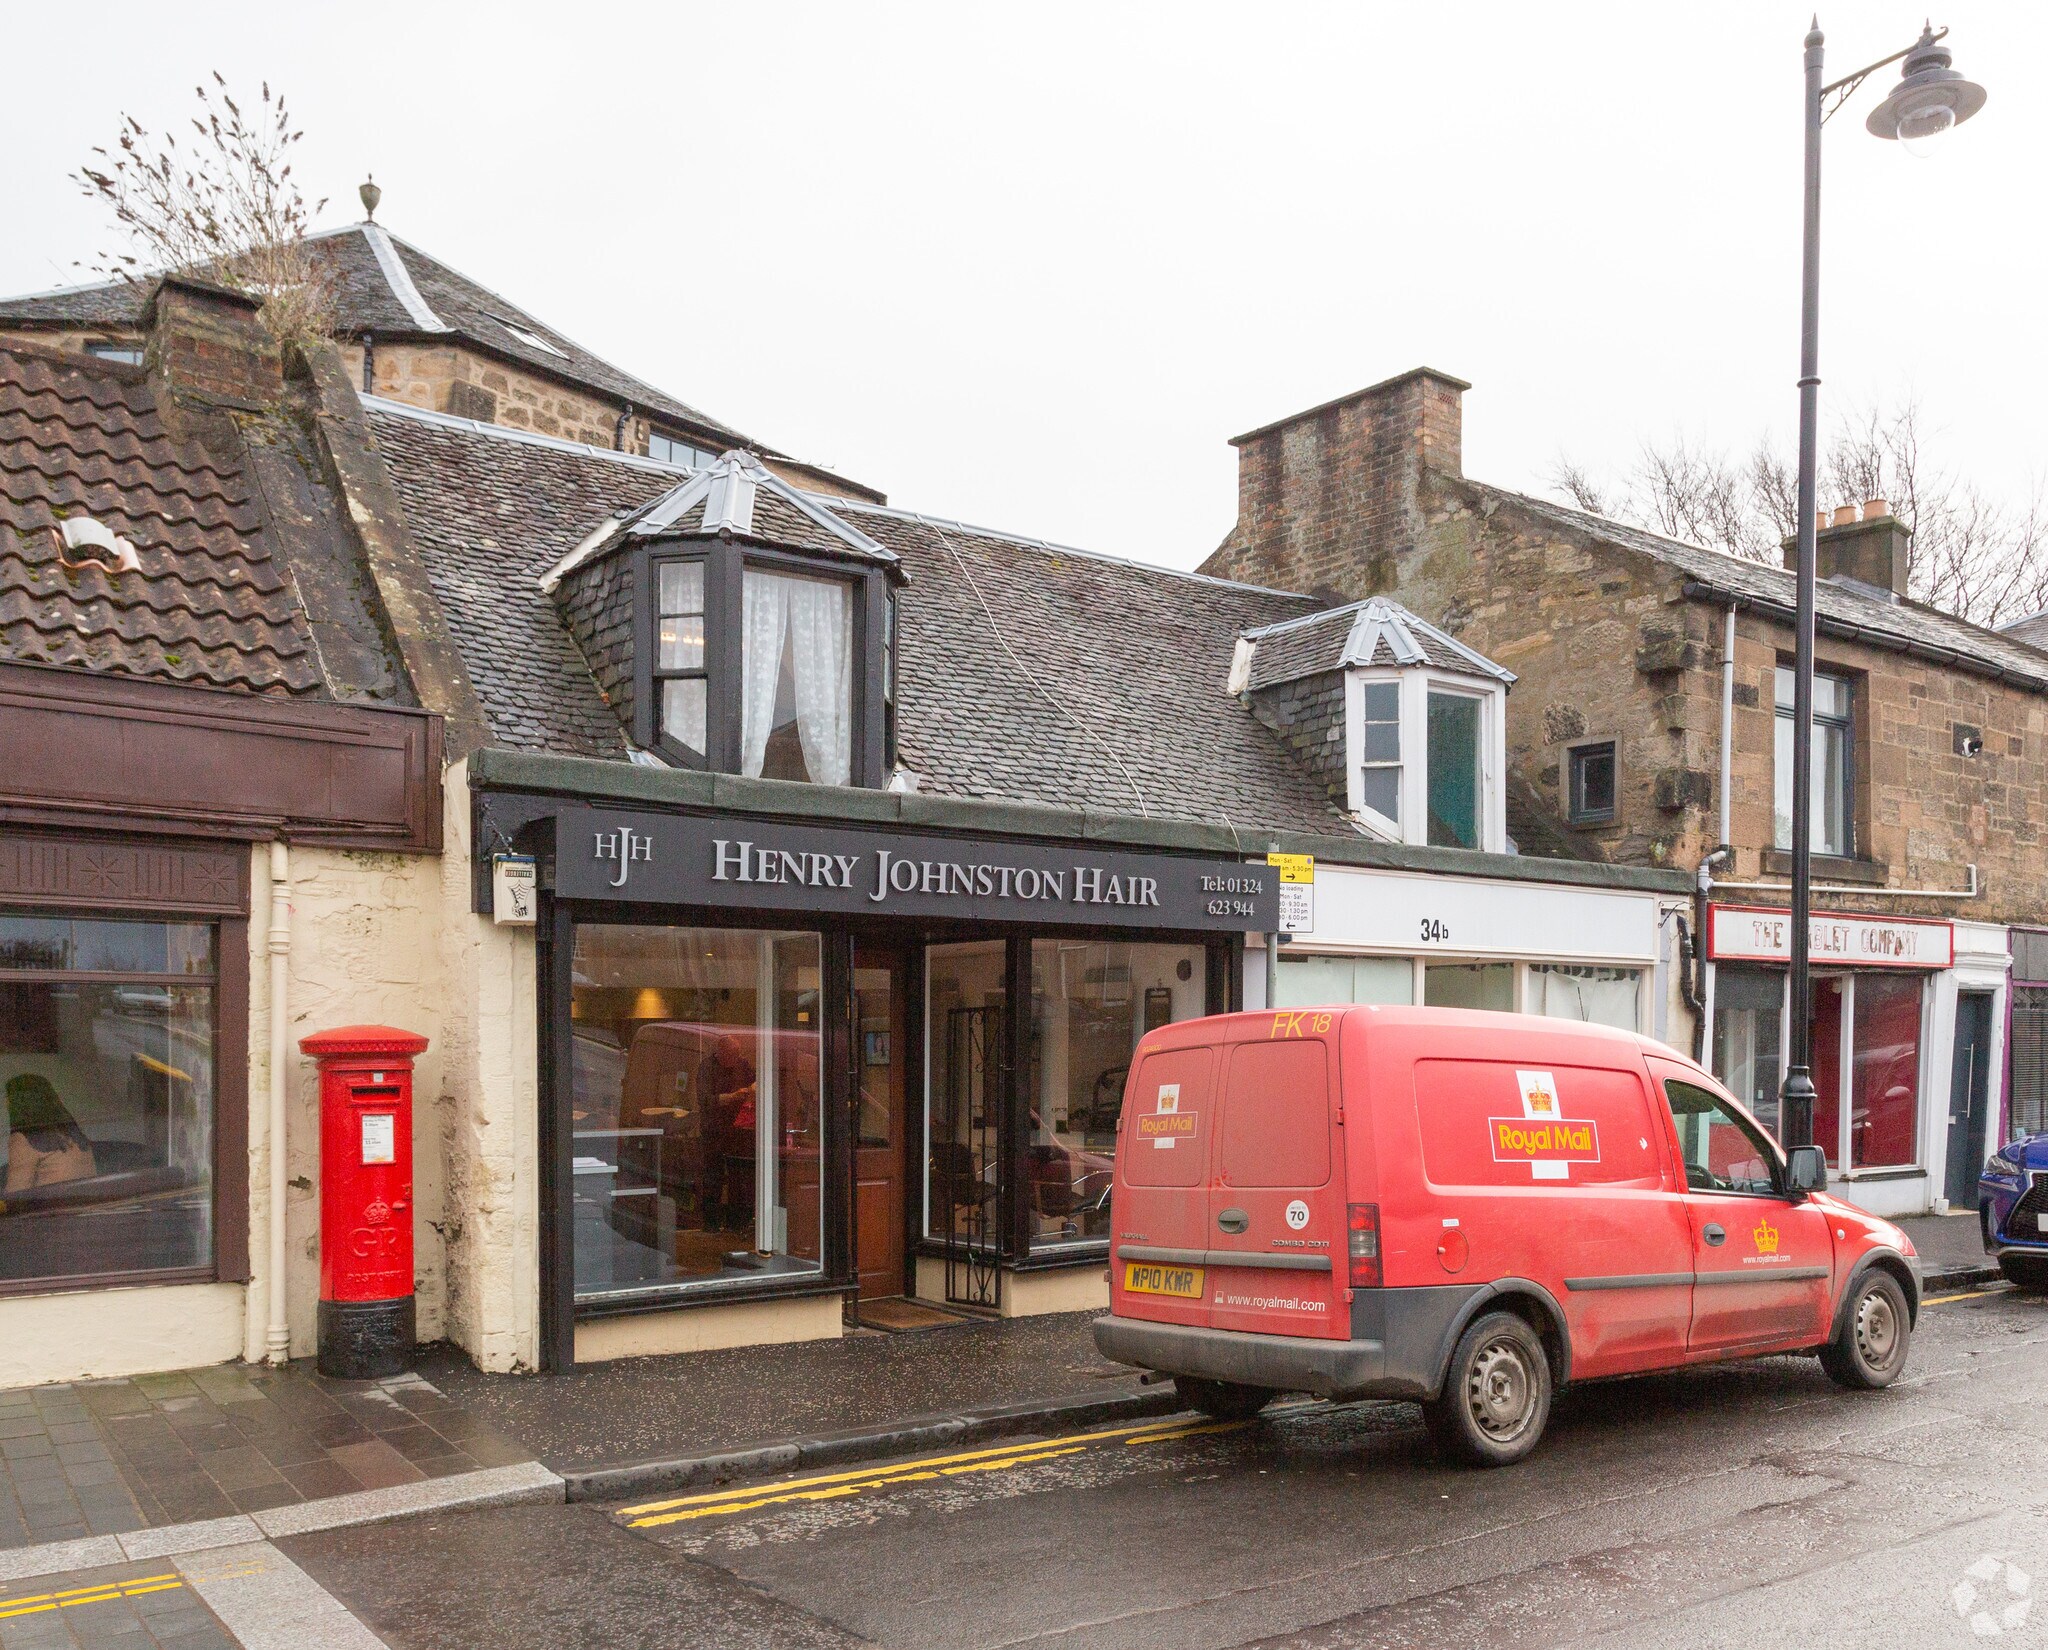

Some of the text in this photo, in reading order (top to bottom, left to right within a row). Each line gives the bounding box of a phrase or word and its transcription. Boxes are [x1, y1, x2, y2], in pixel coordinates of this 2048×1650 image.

[594, 827, 653, 887] HJH
[711, 839, 1160, 906] HENRY JOHNSTON HAIR
[1200, 875, 1263, 894] Tel: 01324
[1208, 900, 1255, 916] 623 944
[1753, 920, 1784, 949] THE
[1861, 928, 1919, 956] COMPANY
[1270, 1011, 1333, 1039] FK 18
[1141, 1116, 1193, 1136] Royal Mail
[1498, 1124, 1592, 1155] Royal Mail
[1290, 1210, 1305, 1222] 70
[1271, 1239, 1305, 1247] COMBO
[1742, 1253, 1791, 1265] www.royalmail.com
[1131, 1266, 1194, 1293] WP10 KWR
[1227, 1294, 1326, 1312] www.royalmail.com
